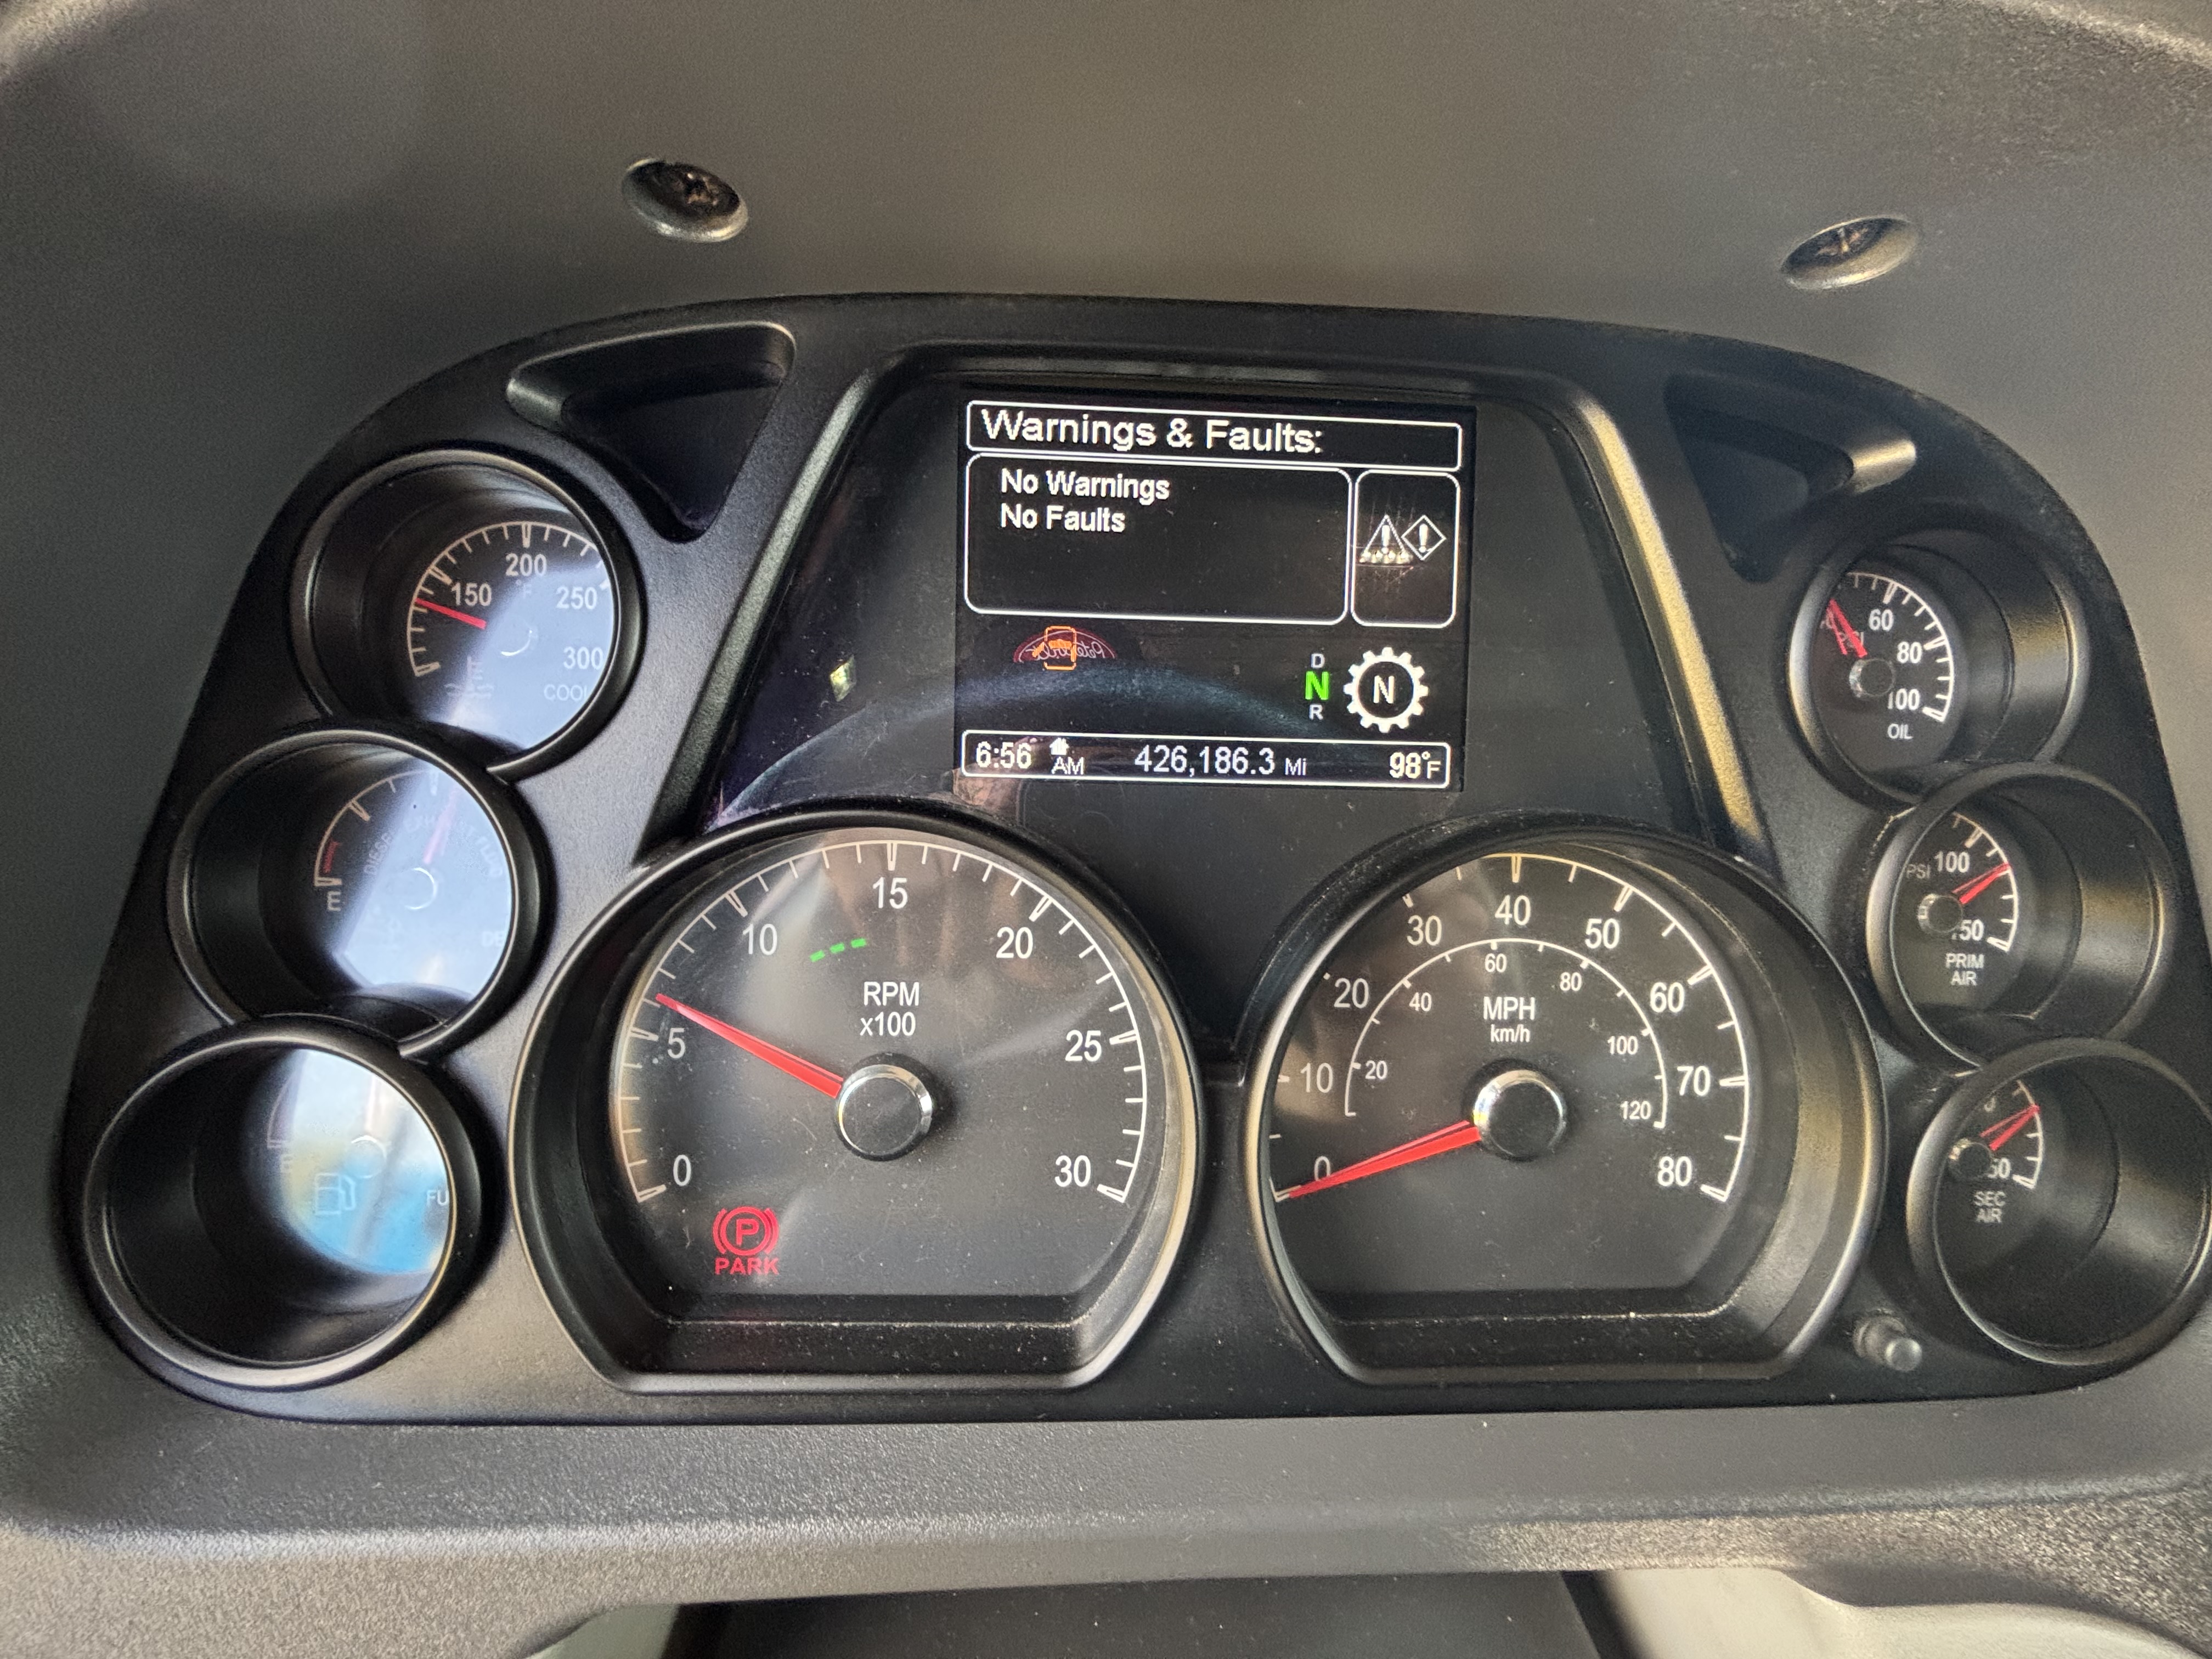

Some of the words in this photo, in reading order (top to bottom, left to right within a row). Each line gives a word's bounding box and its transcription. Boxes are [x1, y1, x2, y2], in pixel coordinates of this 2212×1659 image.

[982, 409, 1156, 451] Warnings
[1167, 418, 1193, 449] &
[1206, 420, 1323, 454] Faults:
[1001, 469, 1038, 494] No
[1046, 472, 1170, 504] Warnings
[1001, 504, 1037, 529] No
[1046, 506, 1126, 533] Faults
[505, 553, 547, 577] 200
[451, 582, 492, 607] 150
[556, 586, 597, 610] 250
[1869, 609, 1893, 631] 60
[563, 646, 603, 670] 300
[1311, 653, 1325, 669] D
[1897, 641, 1921, 664] 80
[1305, 671, 1329, 701] N
[1373, 675, 1395, 704] N
[1887, 689, 1920, 710] 100
[1309, 704, 1324, 720] R
[1887, 724, 1913, 740] OIL
[976, 741, 1032, 769] 6:56
[1051, 757, 1085, 775] AM
[1134, 743, 1276, 777] 426,186.3
[1285, 758, 1307, 776] Mi
[1906, 864, 1931, 879] PSI
[1934, 851, 1970, 873] 100
[327, 891, 341, 911] E
[873, 877, 909, 910] 15
[1494, 895, 1531, 926] 40
[742, 923, 778, 956] 10
[1406, 914, 1442, 946] 30
[1585, 917, 1620, 950] 50
[1951, 919, 1984, 941] 50
[996, 926, 1034, 959] 20
[1485, 953, 1506, 973] 60
[1945, 953, 1985, 969] PRIM
[1560, 971, 1582, 991] 80
[1951, 972, 1977, 986] AIR
[864, 981, 919, 1007] RPM
[1334, 977, 1369, 1009] 20
[1409, 991, 1432, 1012] 40
[1650, 981, 1685, 1012] 60
[1482, 996, 1535, 1021] MPH
[860, 1011, 916, 1037] x100
[1490, 1024, 1530, 1043] km/h
[667, 1028, 686, 1059] 5
[1064, 1030, 1102, 1062] 25
[1606, 1035, 1638, 1055] 100
[1299, 1062, 1333, 1093] 10
[1365, 1061, 1387, 1080] 20
[1677, 1065, 1711, 1096] 70
[1620, 1101, 1651, 1120] 120
[672, 1155, 691, 1187] 0
[1054, 1155, 1091, 1188] 30
[1657, 1156, 1692, 1187] 80
[1974, 1190, 2006, 1206] SEC
[1976, 1208, 2002, 1223] AIR
[715, 1257, 780, 1275] PARK
